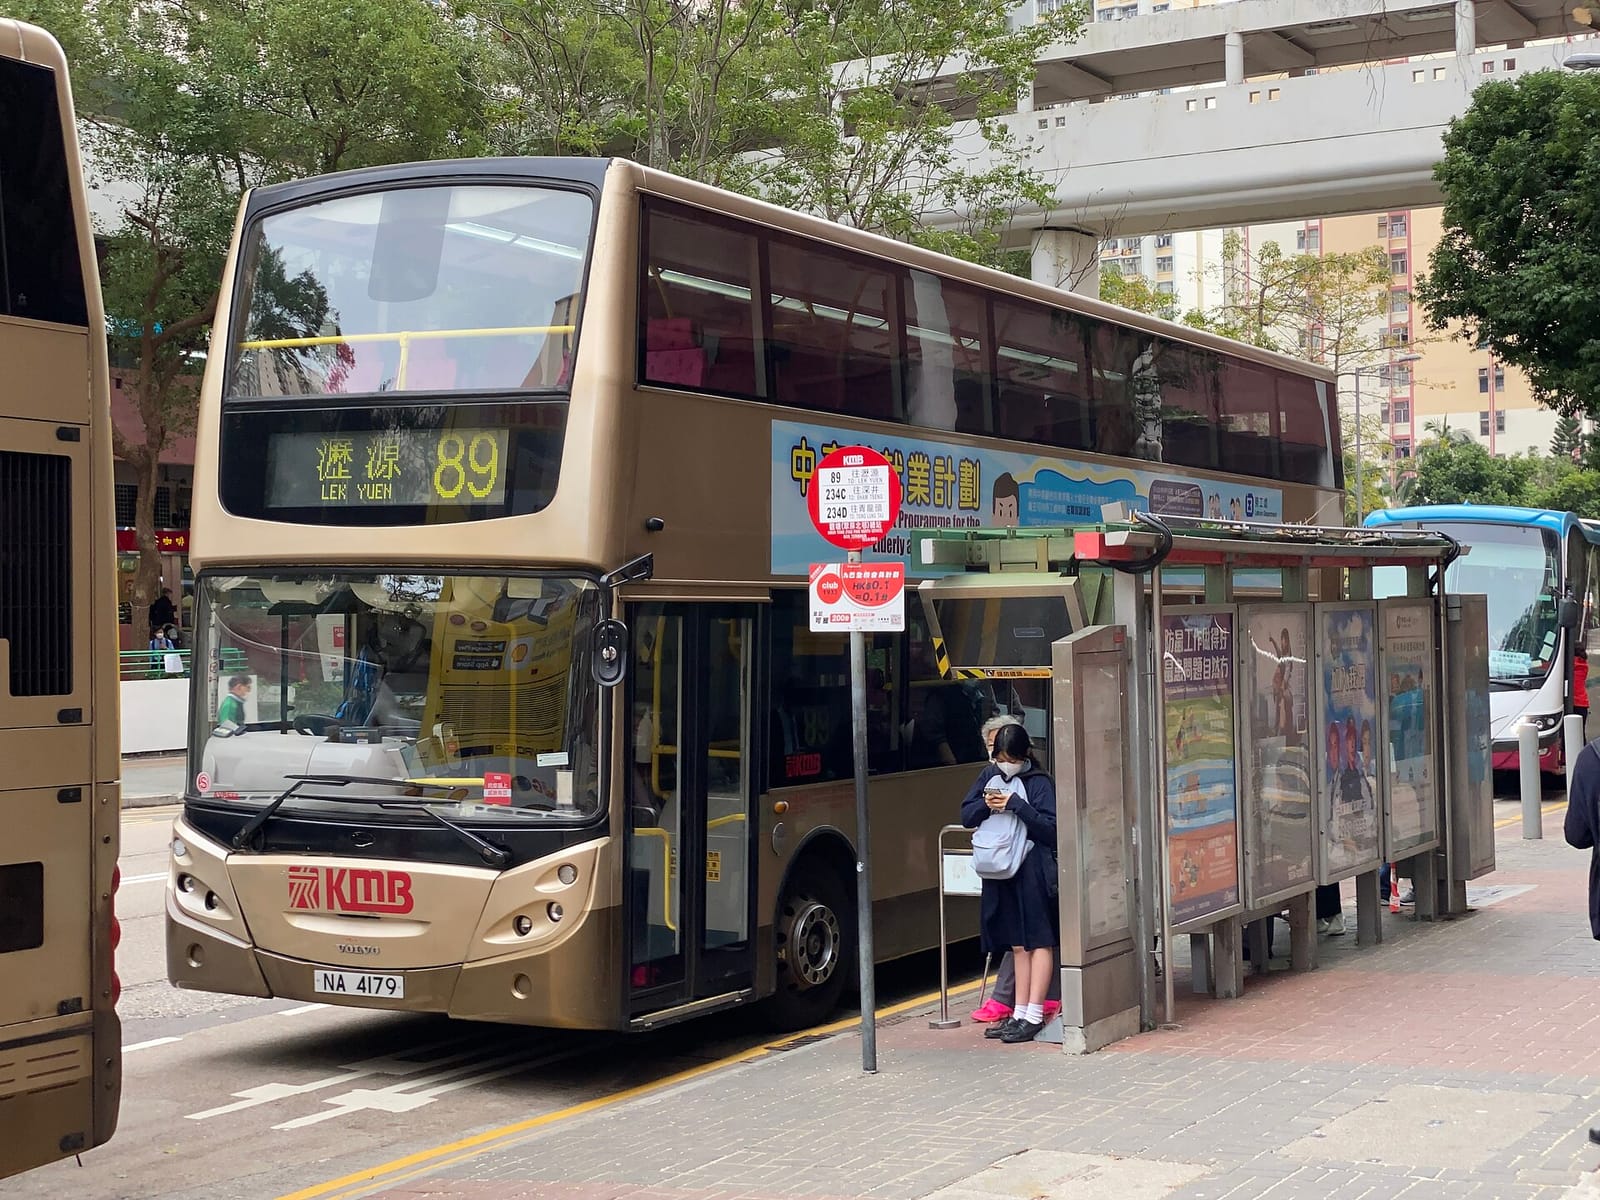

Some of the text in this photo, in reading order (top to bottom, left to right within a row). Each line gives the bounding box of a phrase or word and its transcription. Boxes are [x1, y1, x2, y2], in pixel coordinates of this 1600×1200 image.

[433, 431, 498, 500] 89
[842, 455, 864, 466] KMB
[791, 436, 981, 511] 中業計劃
[830, 471, 841, 484] 89
[321, 482, 392, 500] LEK YUEN
[825, 488, 846, 501] 234C
[826, 506, 848, 519] 234D
[898, 510, 981, 529] Programme for the
[821, 581, 839, 589] club
[852, 580, 890, 590] HK$0.1
[326, 868, 414, 915] KMB
[336, 943, 381, 955] VOLVO
[322, 972, 397, 995] NA 4179
